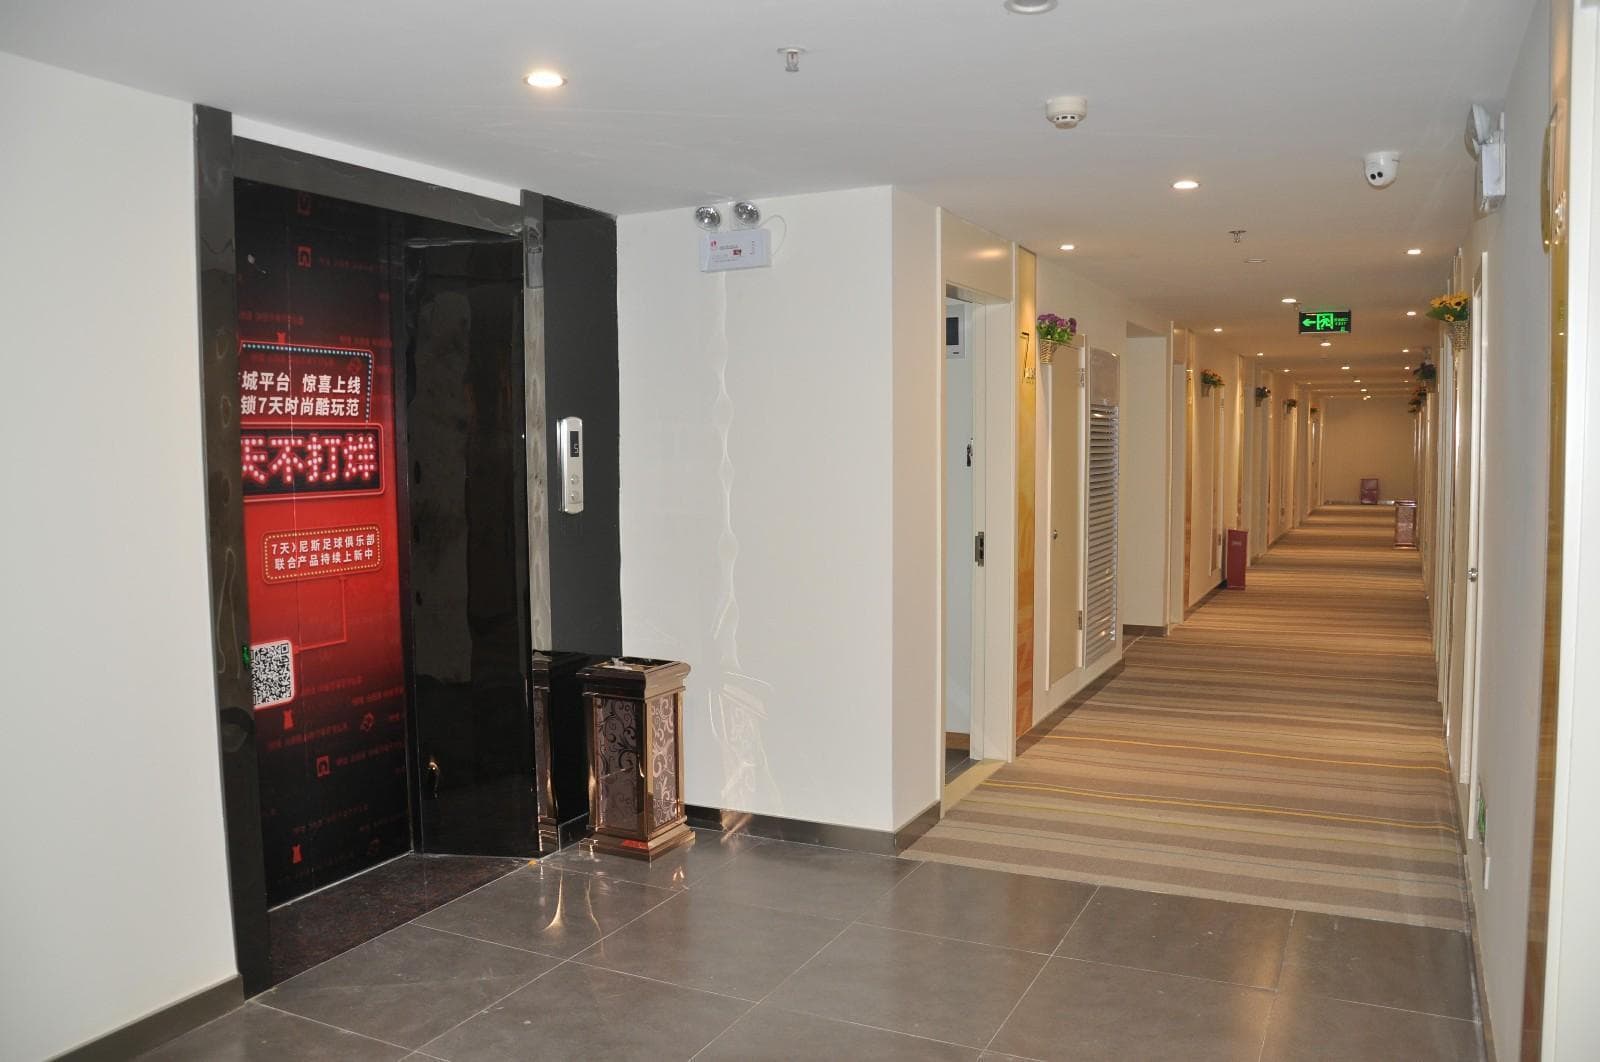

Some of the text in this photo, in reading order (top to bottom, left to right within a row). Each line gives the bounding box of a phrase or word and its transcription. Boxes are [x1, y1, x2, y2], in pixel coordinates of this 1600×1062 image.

[242, 371, 361, 395] 城平台 惊喜上线
